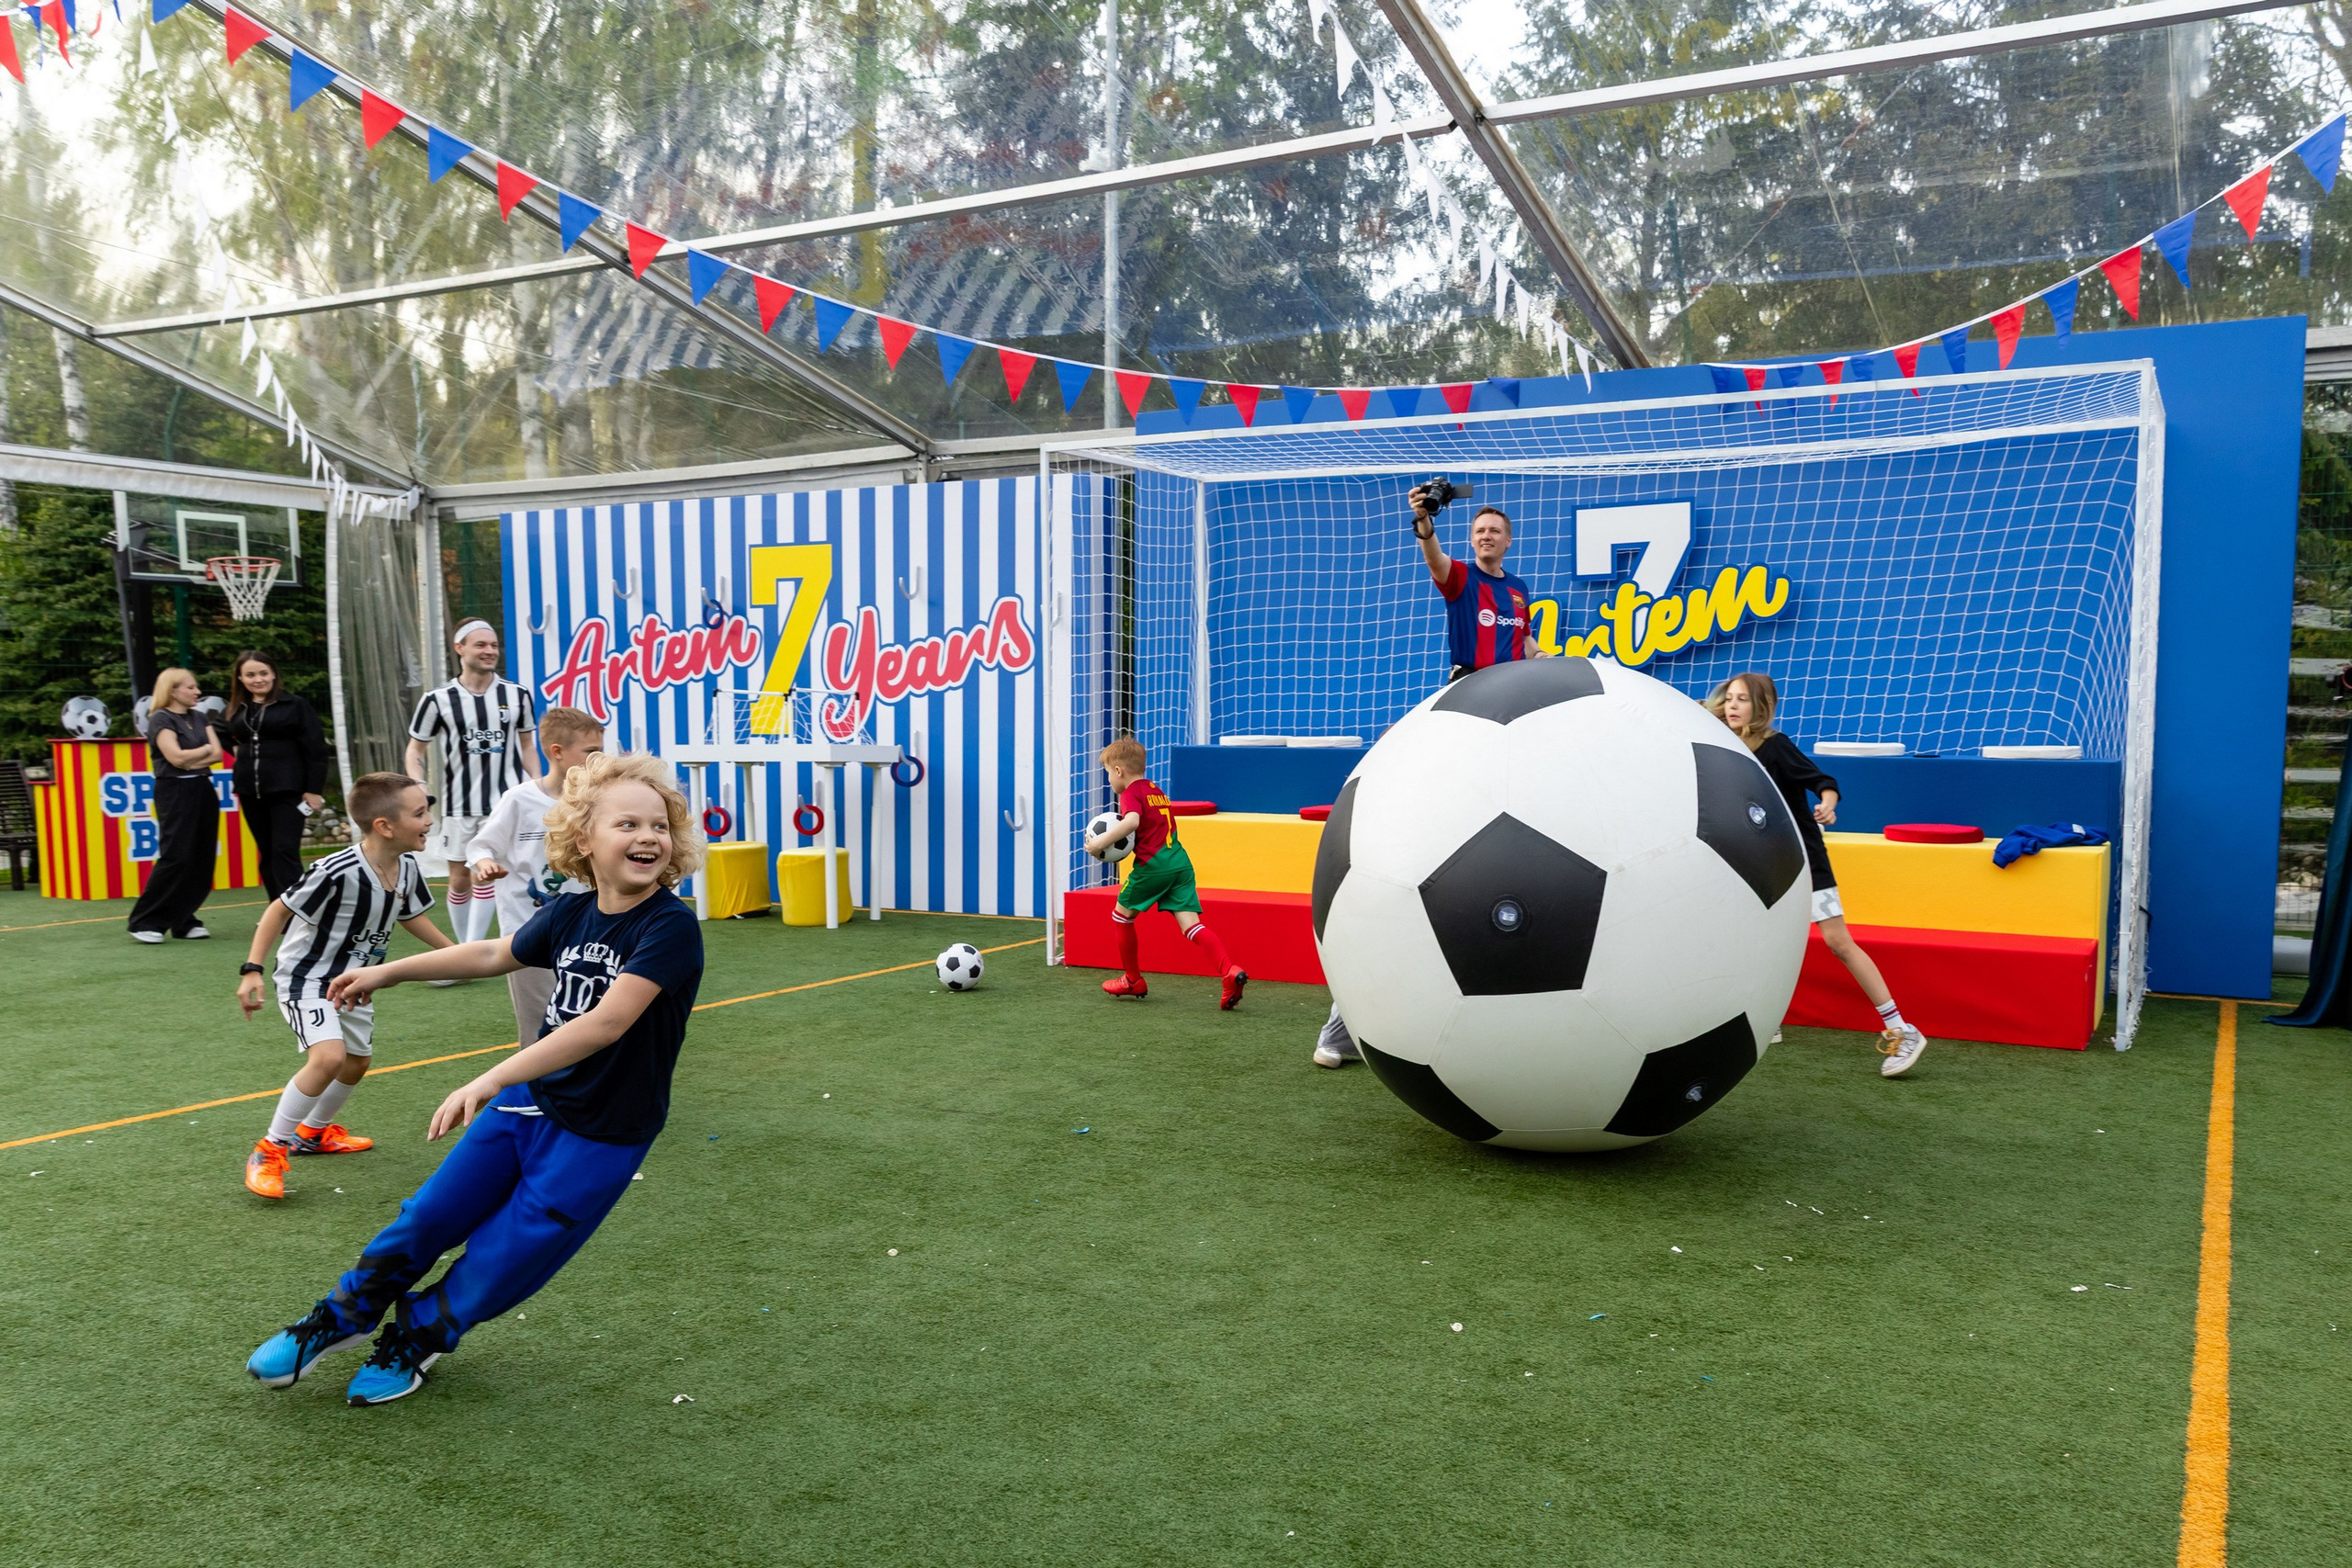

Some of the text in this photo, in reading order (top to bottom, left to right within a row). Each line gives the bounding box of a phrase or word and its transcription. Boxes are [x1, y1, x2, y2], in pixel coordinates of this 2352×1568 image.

[1576, 502, 1691, 660] 7
[1497, 615, 1525, 629] Spotify
[1529, 565, 1790, 666] rtem
[544, 544, 1032, 739] Artem 7 Years
[463, 729, 505, 741] Jeep
[103, 769, 236, 814] SPT
[1159, 808, 1172, 849] 7
